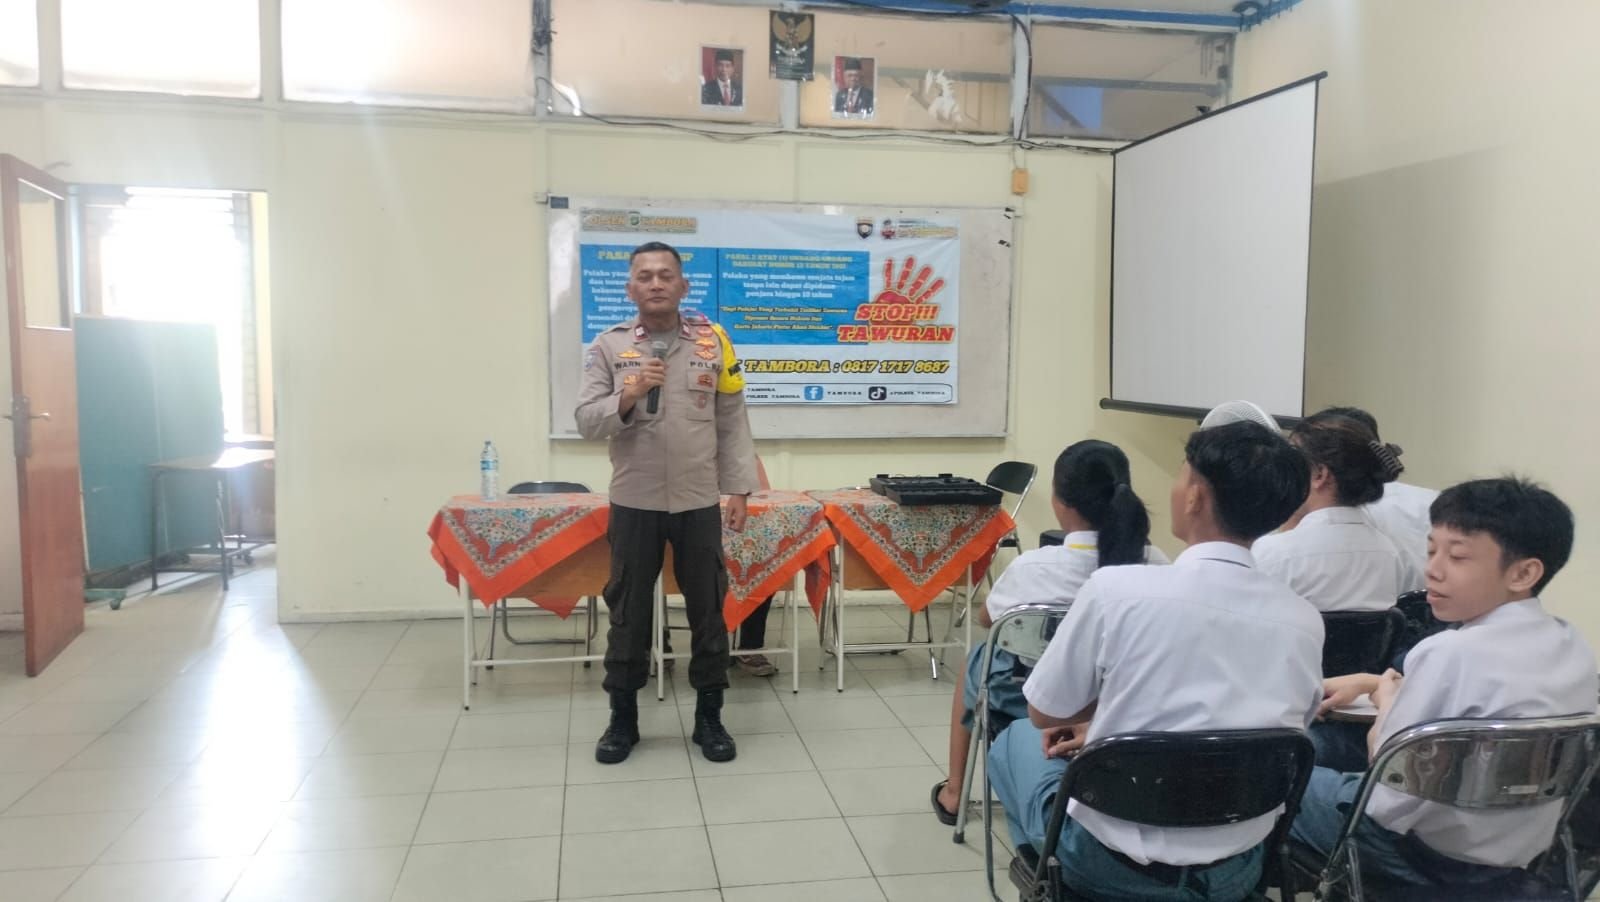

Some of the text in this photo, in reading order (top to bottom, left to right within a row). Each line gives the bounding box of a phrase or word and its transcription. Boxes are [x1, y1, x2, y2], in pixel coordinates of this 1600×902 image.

[837, 325, 955, 343] TAWURAN
[744, 359, 831, 373] TAMBORA
[841, 359, 879, 373] 0817
[879, 359, 918, 373] 1717
[914, 359, 950, 373] 8687
